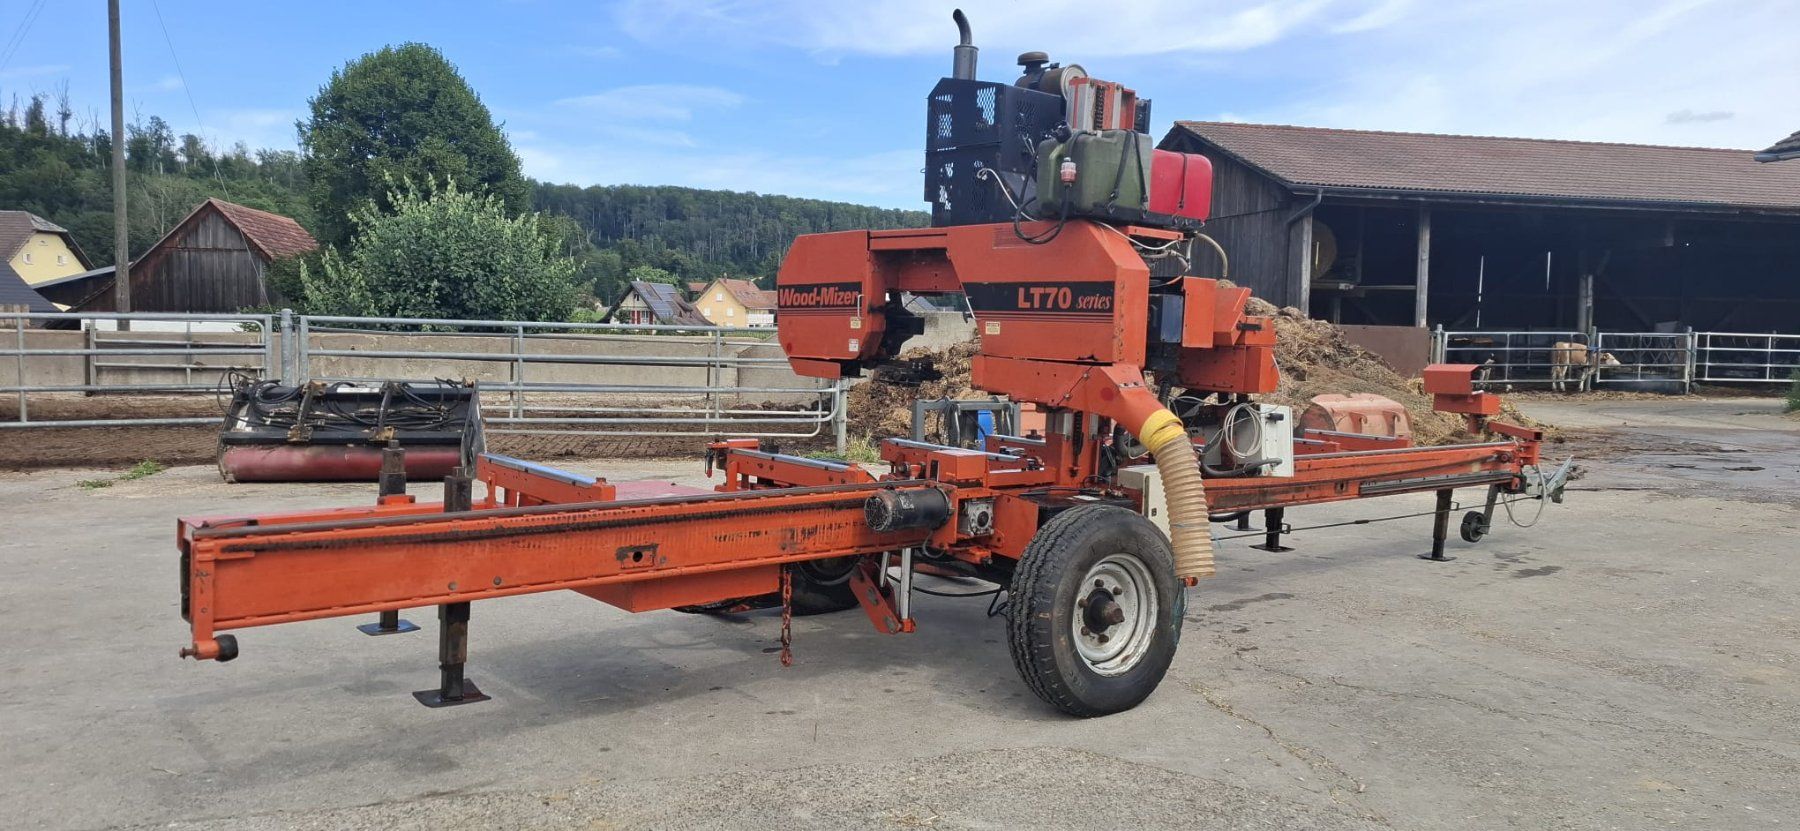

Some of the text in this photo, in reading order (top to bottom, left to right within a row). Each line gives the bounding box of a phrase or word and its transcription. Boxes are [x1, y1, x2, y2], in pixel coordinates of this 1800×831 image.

[779, 286, 859, 306] Wood-Mizer
[1018, 287, 1112, 309] LT70 series
